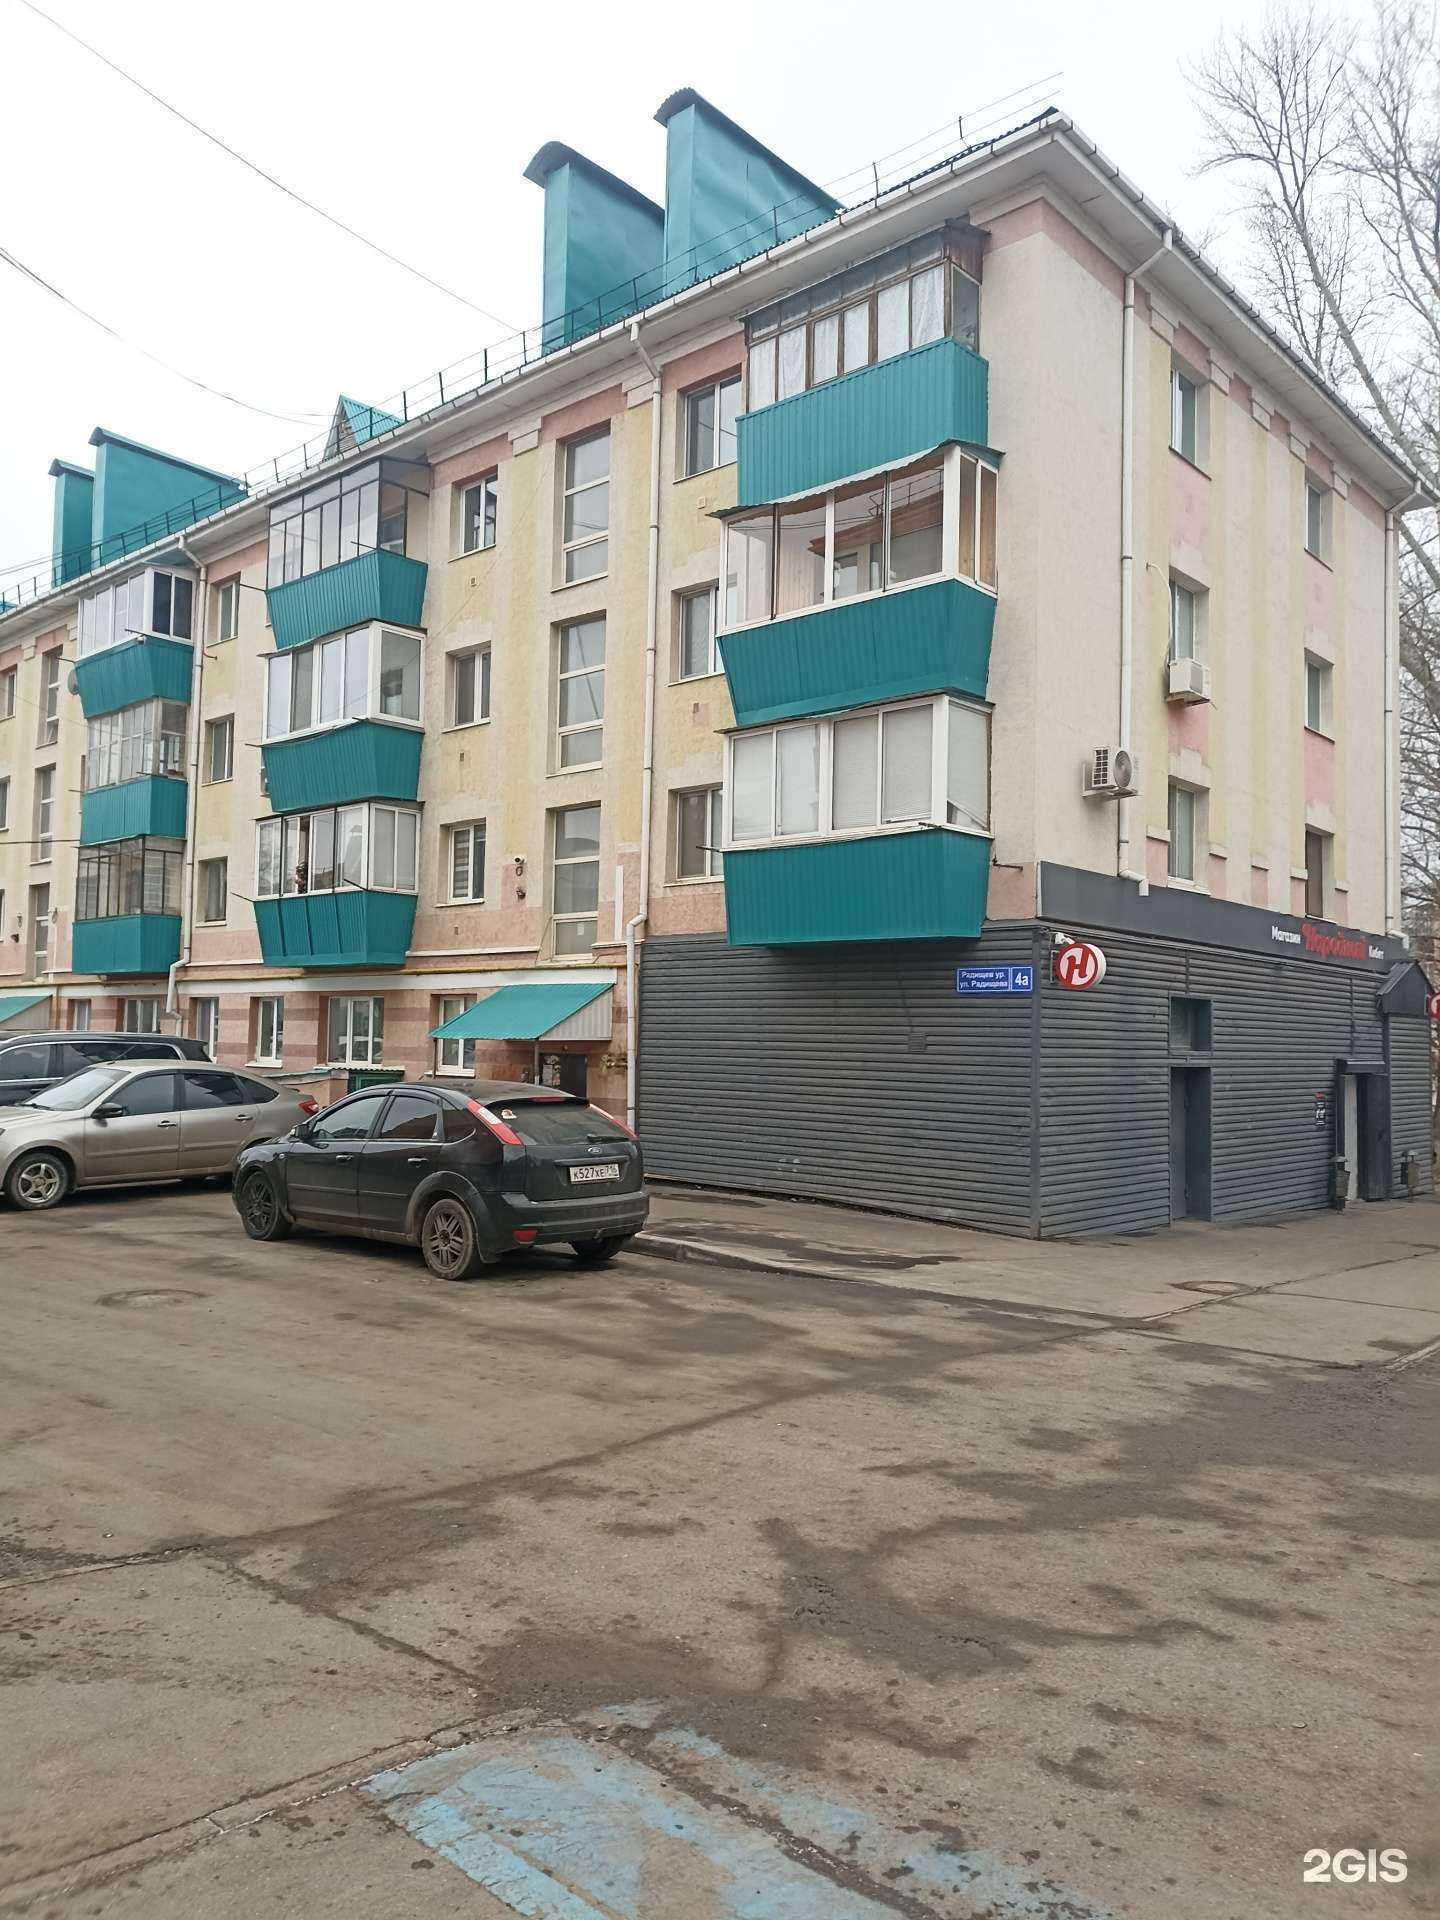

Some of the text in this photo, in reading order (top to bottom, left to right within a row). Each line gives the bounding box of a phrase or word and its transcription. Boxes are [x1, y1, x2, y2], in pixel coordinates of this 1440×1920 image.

[961, 971, 1006, 979] Радищев ур.
[1014, 972, 1029, 986] 4а
[959, 981, 970, 989] ул.
